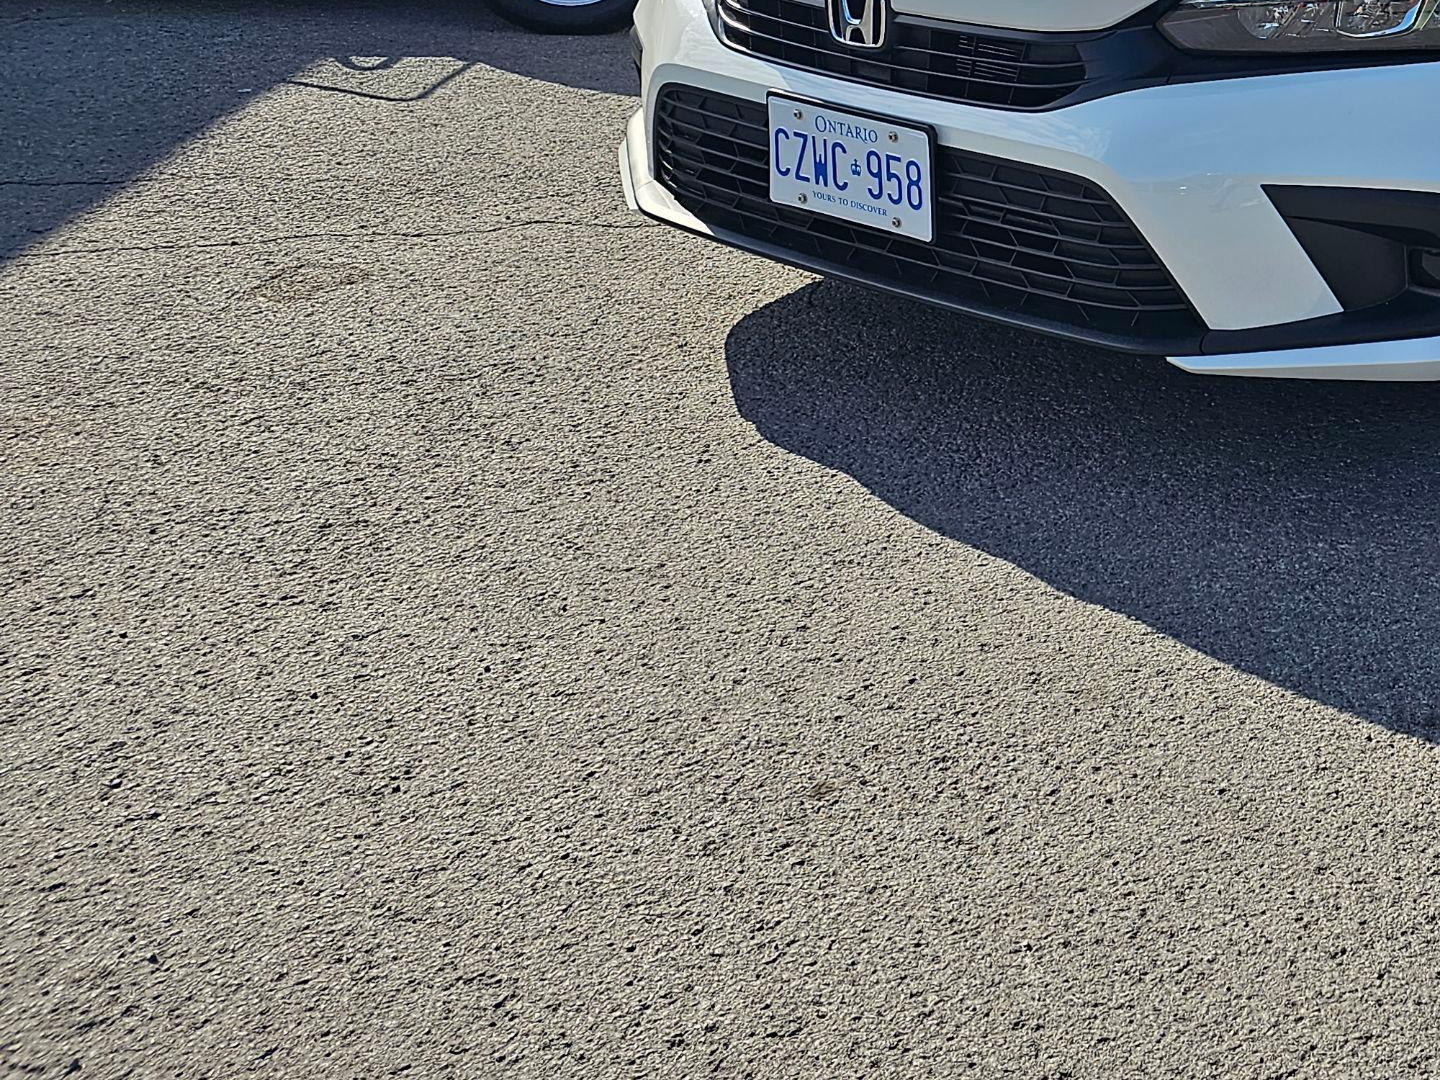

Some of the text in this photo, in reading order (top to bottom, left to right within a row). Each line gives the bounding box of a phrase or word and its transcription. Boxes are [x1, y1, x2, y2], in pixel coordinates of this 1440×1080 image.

[815, 115, 878, 144] ONTARIO
[774, 127, 923, 211] CZWC 958
[812, 190, 888, 216] YOURS TO DISCOVER
